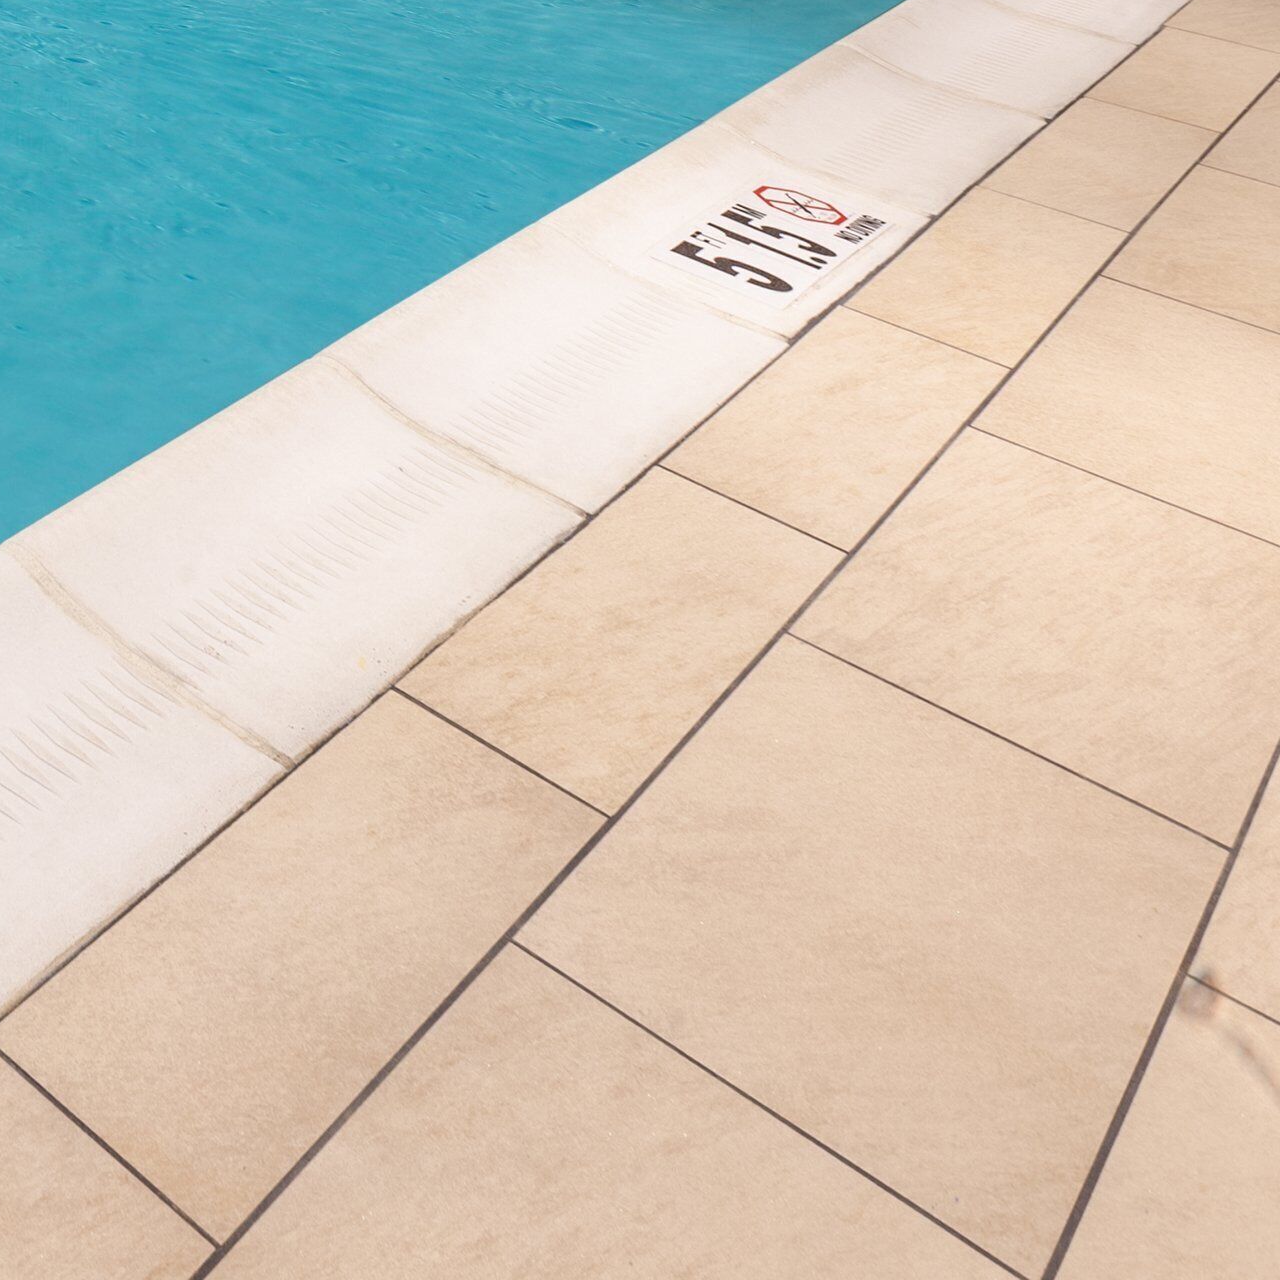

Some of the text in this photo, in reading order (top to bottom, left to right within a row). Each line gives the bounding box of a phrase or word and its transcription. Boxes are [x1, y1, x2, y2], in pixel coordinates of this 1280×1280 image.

[690, 230, 727, 249] FT
[707, 209, 837, 270] 1.5
[834, 215, 886, 244] NO DIVING
[670, 240, 793, 292] 5
